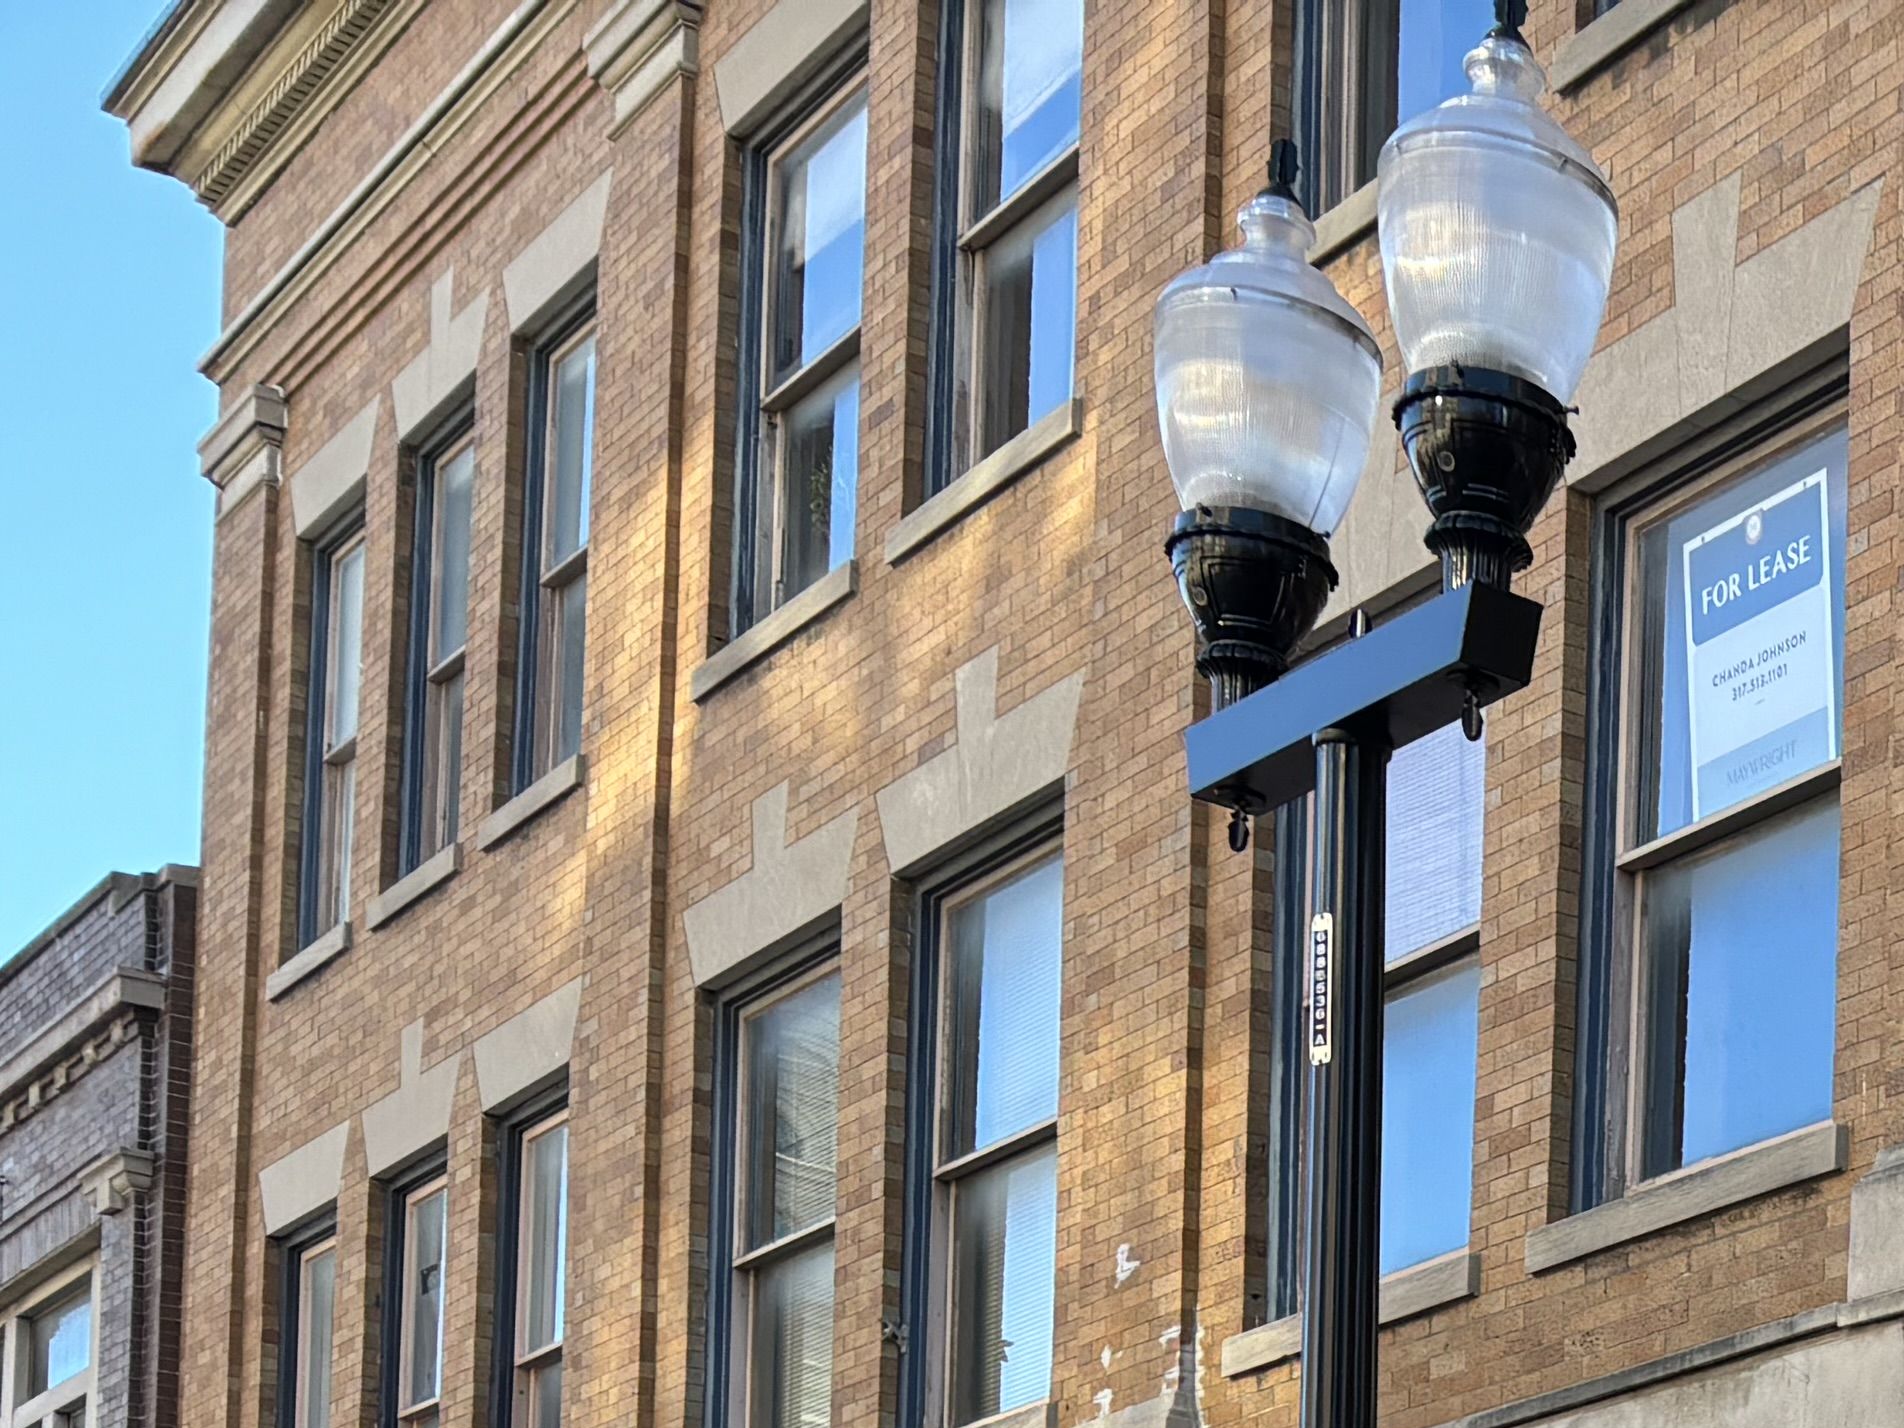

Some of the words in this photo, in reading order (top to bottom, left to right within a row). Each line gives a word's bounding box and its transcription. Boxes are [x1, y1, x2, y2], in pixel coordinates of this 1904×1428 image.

[1702, 572, 1741, 616] FOR
[1748, 534, 1812, 591] LEASE
[1712, 656, 1755, 688] CHANDA
[1757, 630, 1808, 669] JOHNSON
